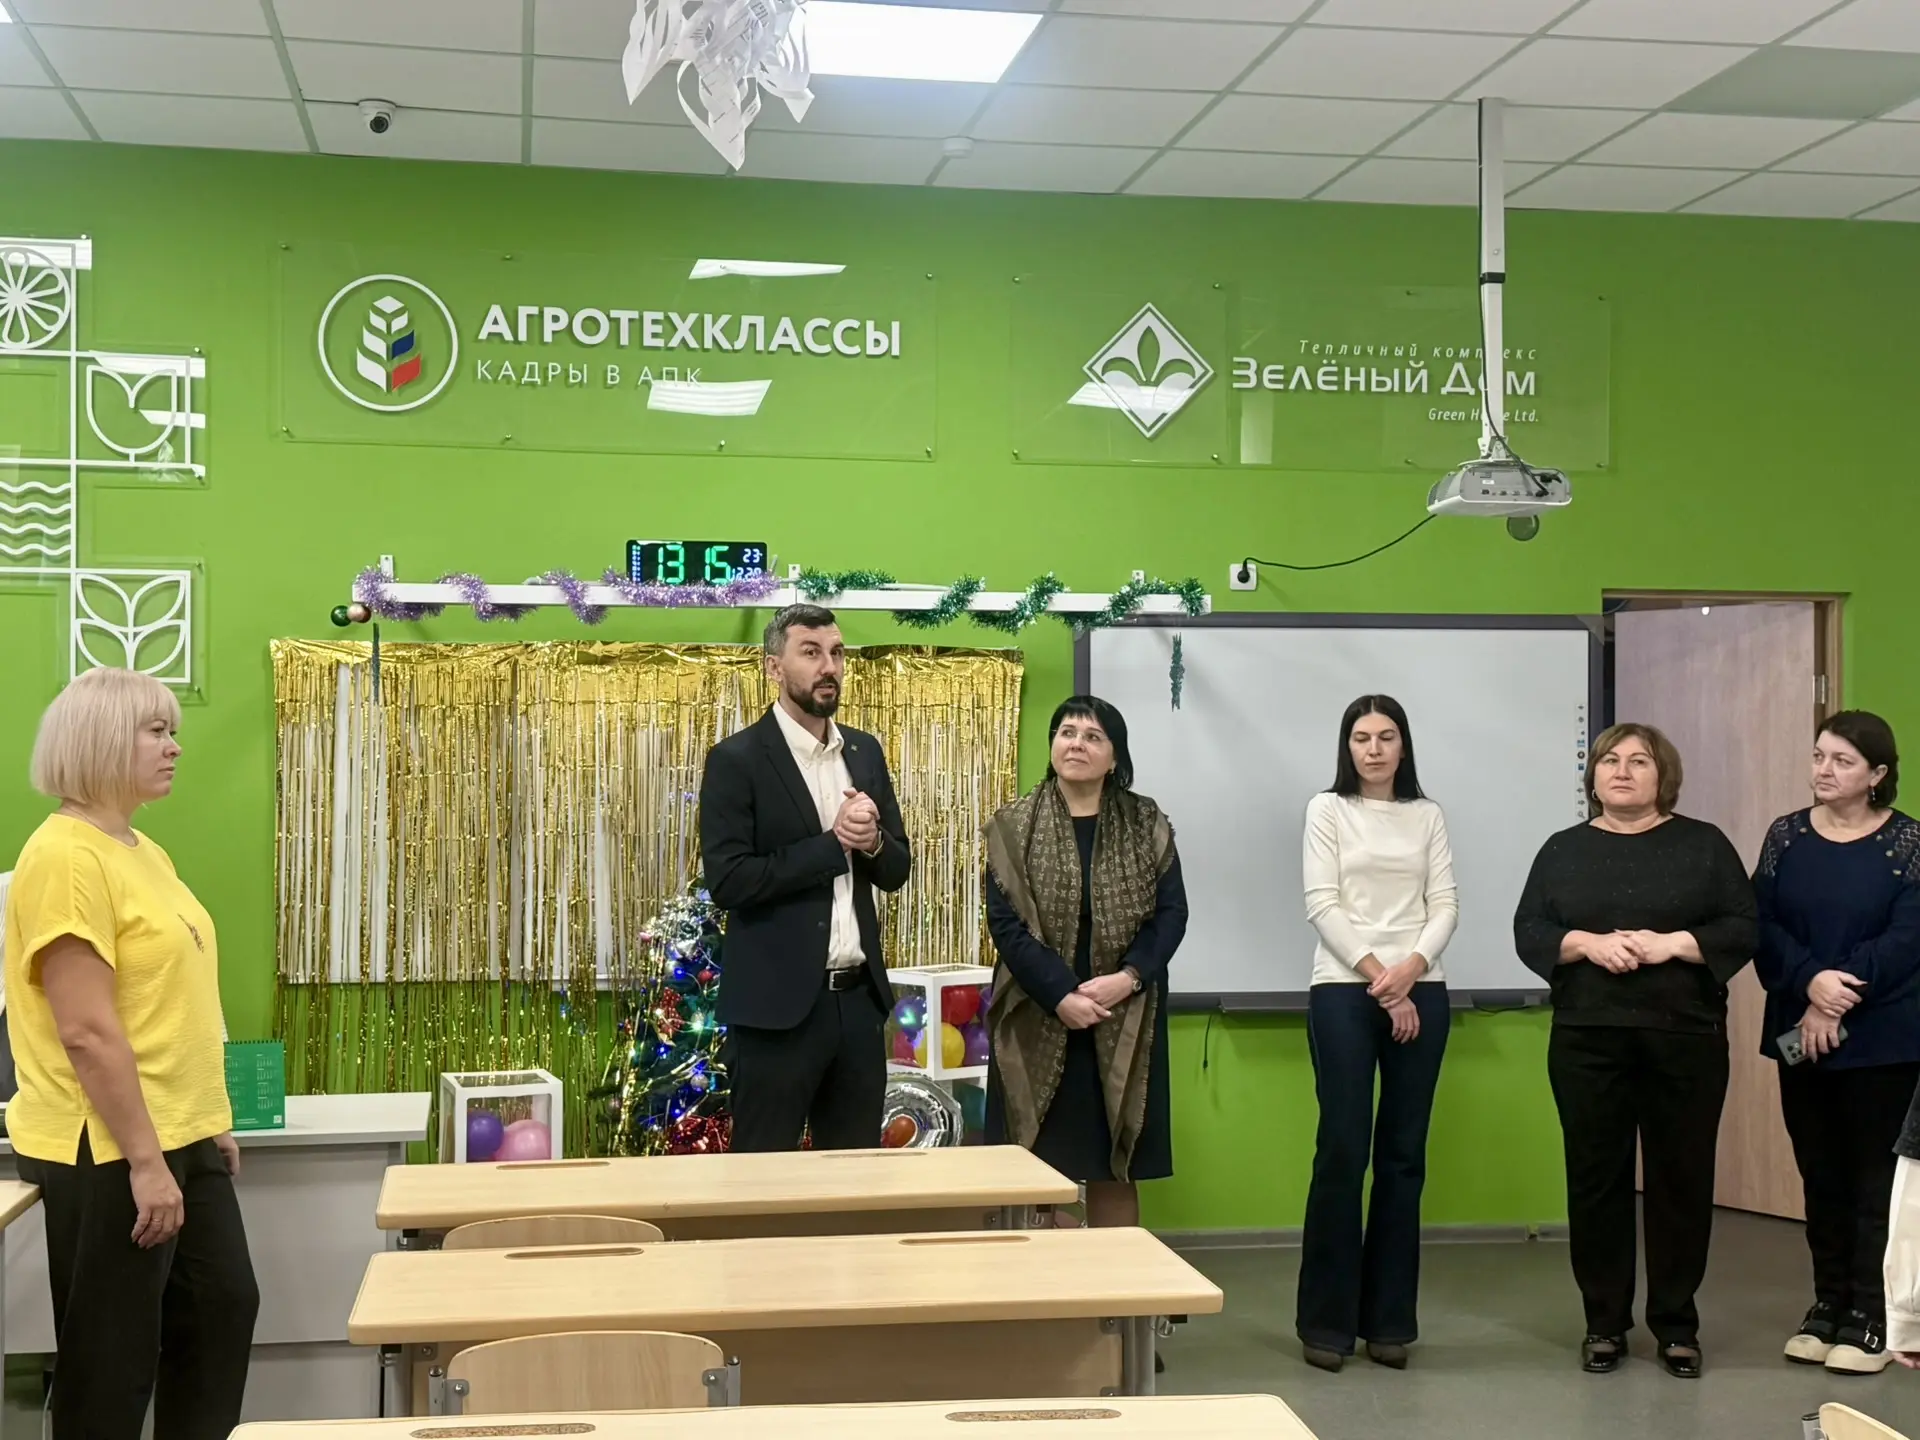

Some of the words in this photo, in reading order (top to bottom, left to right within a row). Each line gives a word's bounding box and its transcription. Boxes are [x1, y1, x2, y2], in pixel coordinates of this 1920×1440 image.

[478, 304, 900, 356] АГРОТЕХКЛАССЫ
[1300, 339, 1417, 357] Тепличный
[1433, 346, 1537, 360] компекс
[477, 360, 588, 385] КАДРЫ
[606, 364, 621, 385] В
[637, 366, 701, 386] АПК
[1232, 357, 1428, 394] Зелёный
[1440, 362, 1535, 395] Дм
[1428, 408, 1465, 421] Green
[1514, 409, 1539, 422] Ltd.
[658, 545, 685, 584] 13
